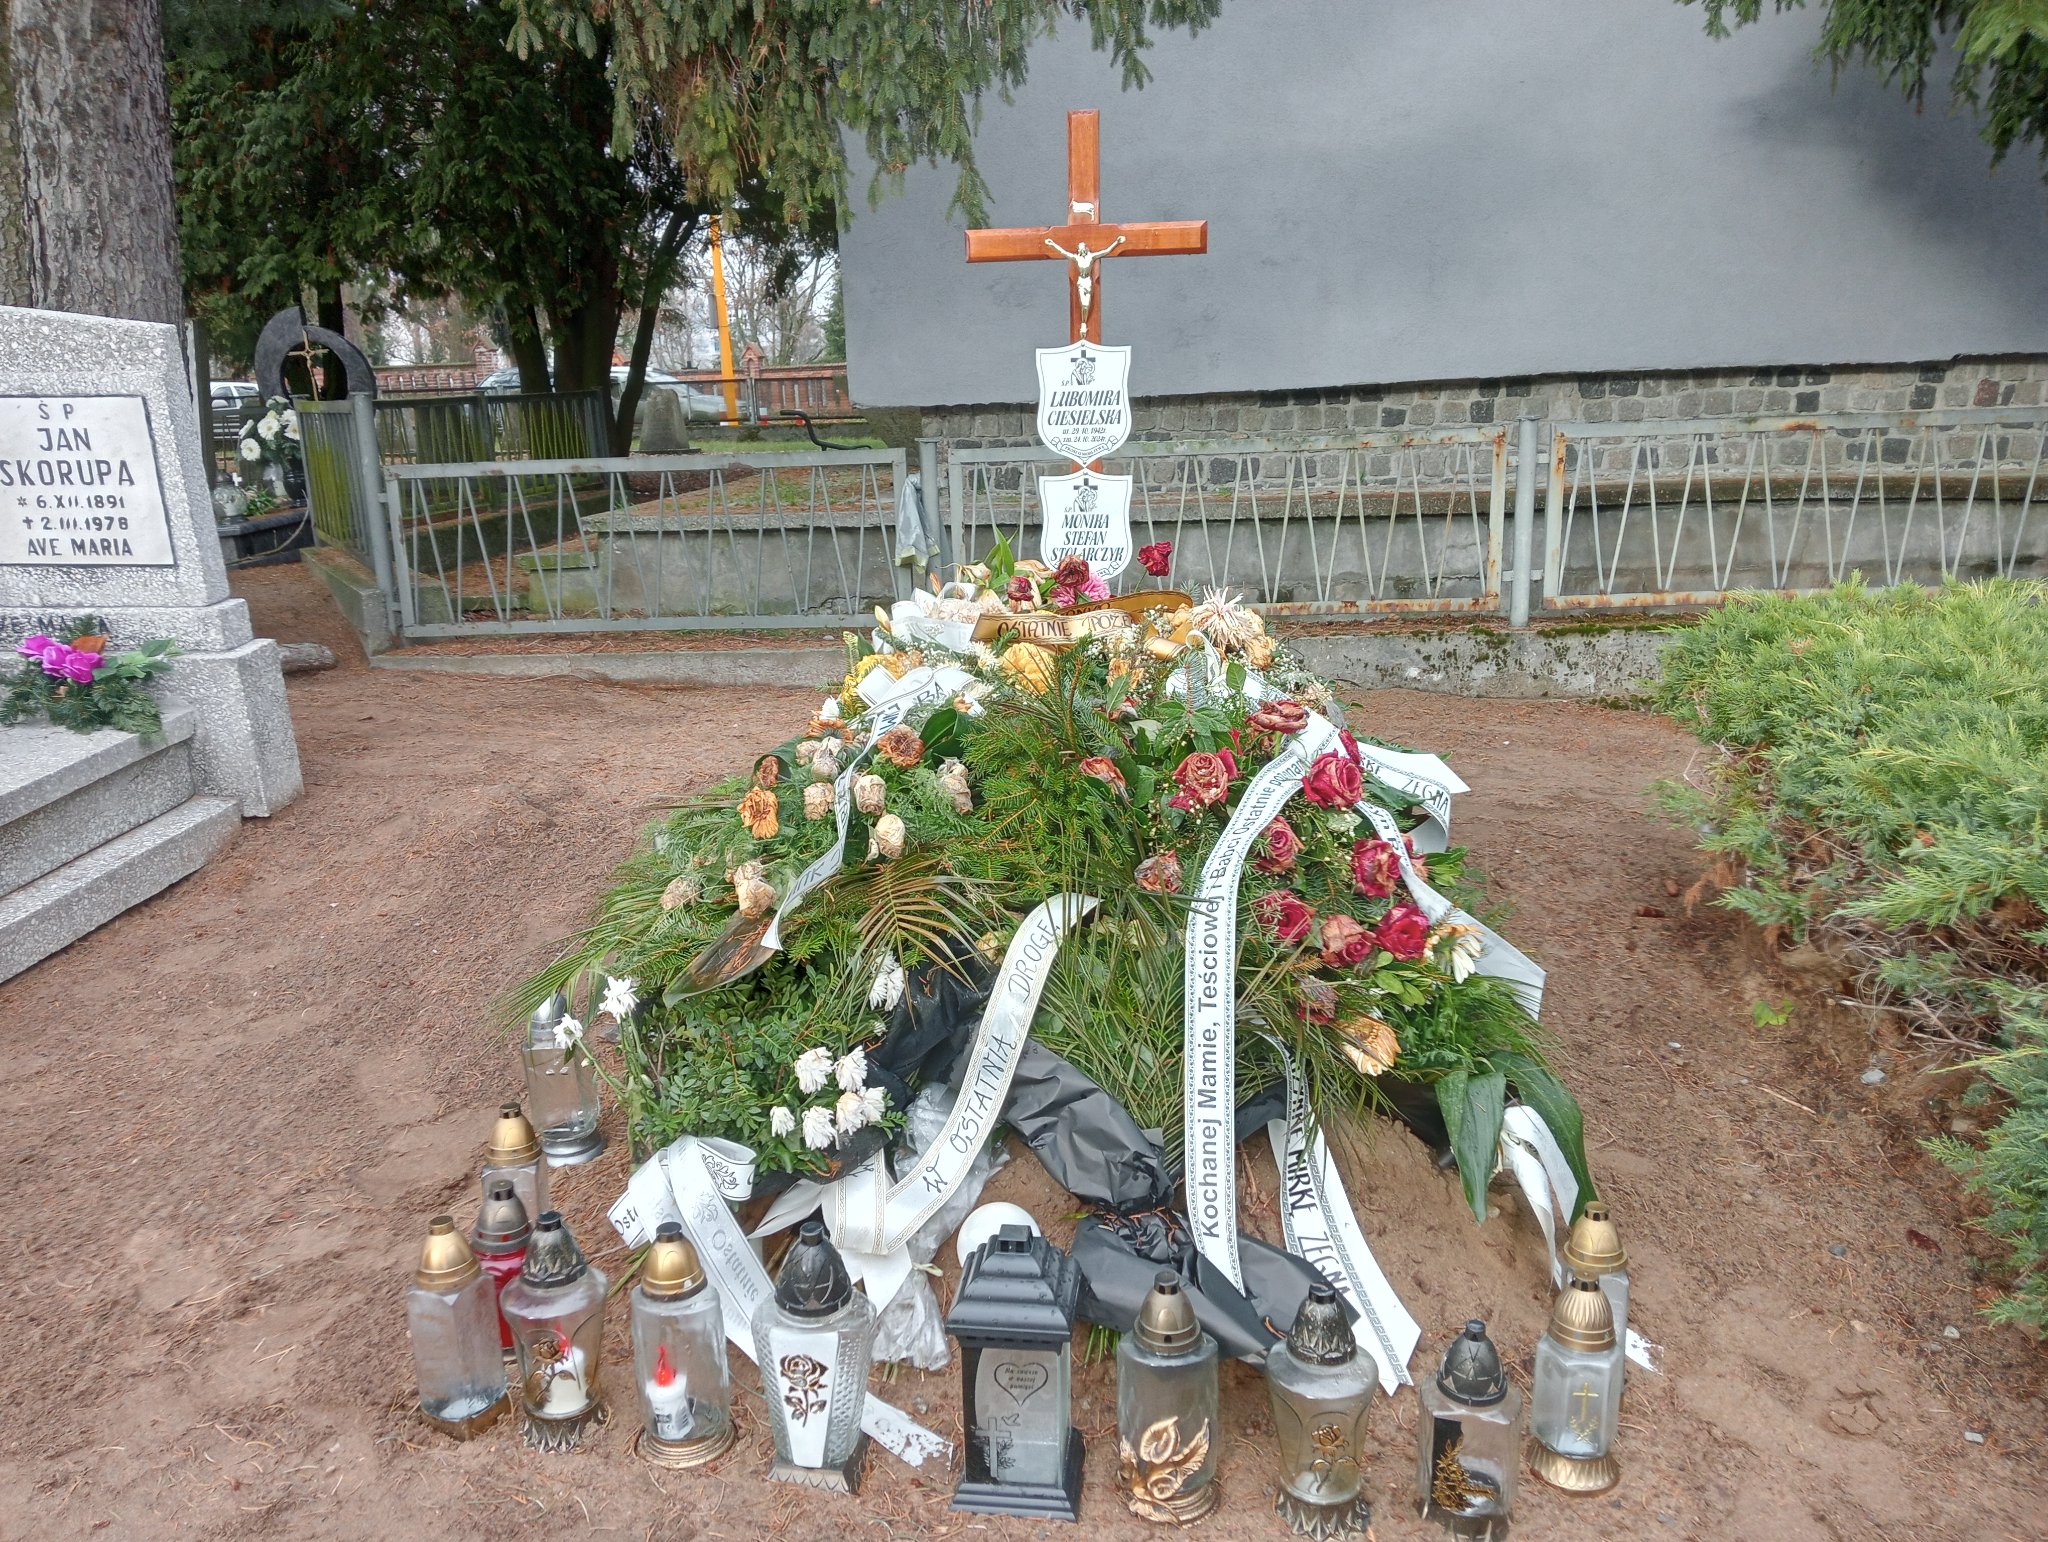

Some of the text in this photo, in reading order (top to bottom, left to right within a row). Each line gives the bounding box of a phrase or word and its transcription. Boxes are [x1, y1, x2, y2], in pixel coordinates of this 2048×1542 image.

[63, 403, 74, 420] P
[1050, 390, 1120, 407] LUBOMIRA
[1047, 409, 1121, 425] CIESIELSKA
[37, 427, 92, 451] JAN
[0, 459, 135, 487] SKORUPA
[1061, 514, 1109, 528] MONIKA
[28, 538, 133, 556] AVE MARIA
[1063, 531, 1107, 545] STEFAN
[1233, 786, 1275, 835] Ostatnie
[1210, 837, 1241, 879] Babci
[1198, 895, 1224, 1012] Teściowej
[1198, 1022, 1221, 1108] Mamie,
[922, 1154, 947, 1194] W
[1198, 1118, 1222, 1238] Kochanej
